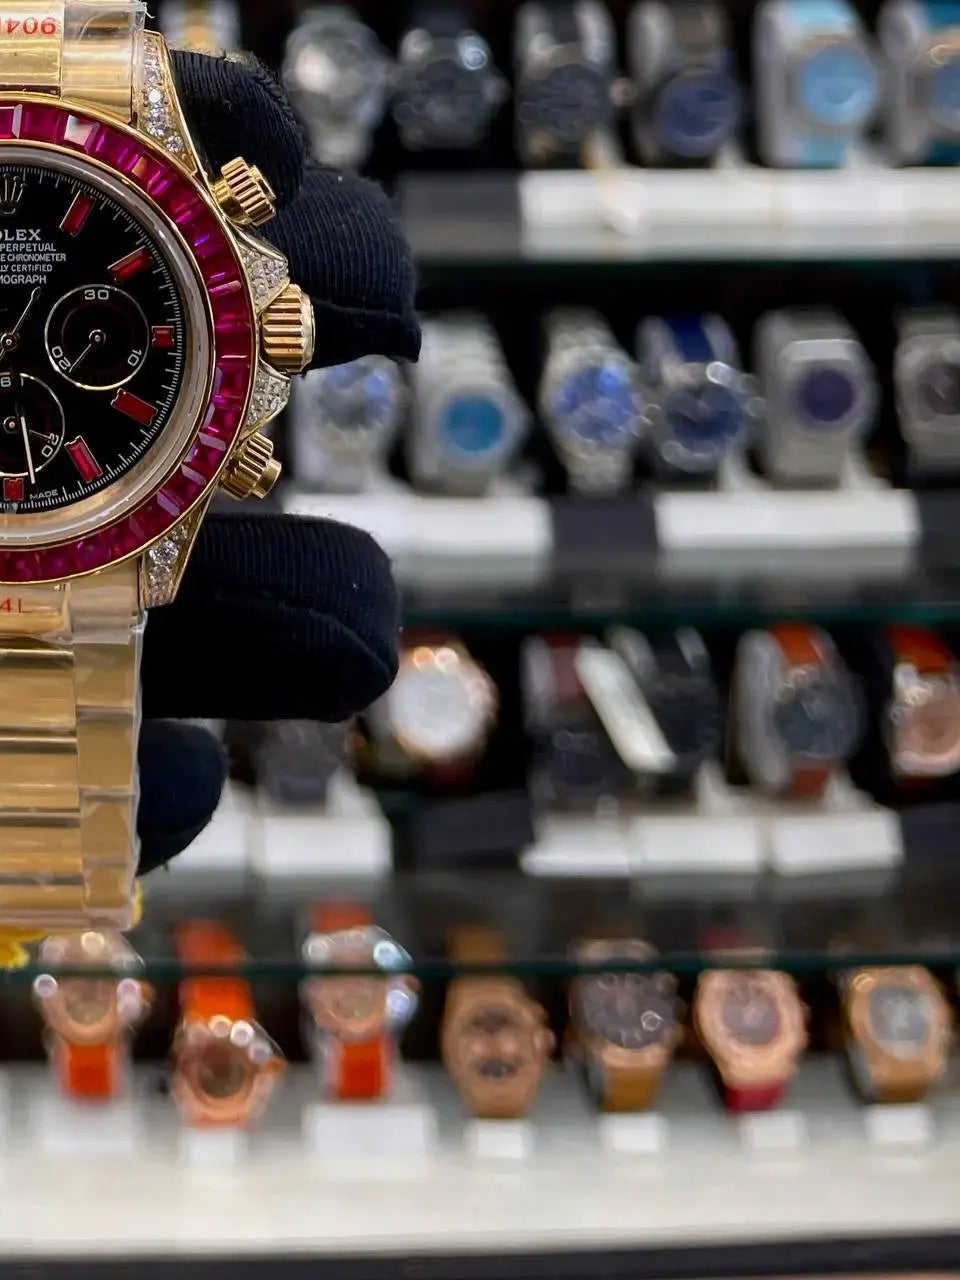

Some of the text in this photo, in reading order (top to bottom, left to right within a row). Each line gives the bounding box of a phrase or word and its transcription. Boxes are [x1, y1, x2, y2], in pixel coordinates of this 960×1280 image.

[0, 243, 56, 252] PERPETUAL
[7, 253, 66, 262] CHRONOMETER
[11, 264, 53, 272] CERTIFIED
[84, 289, 109, 301] 30
[51, 345, 71, 370] 20
[127, 349, 142, 367] 10
[0, 376, 24, 387] 6
[41, 432, 59, 458] 20
[29, 489, 58, 500] MADE
